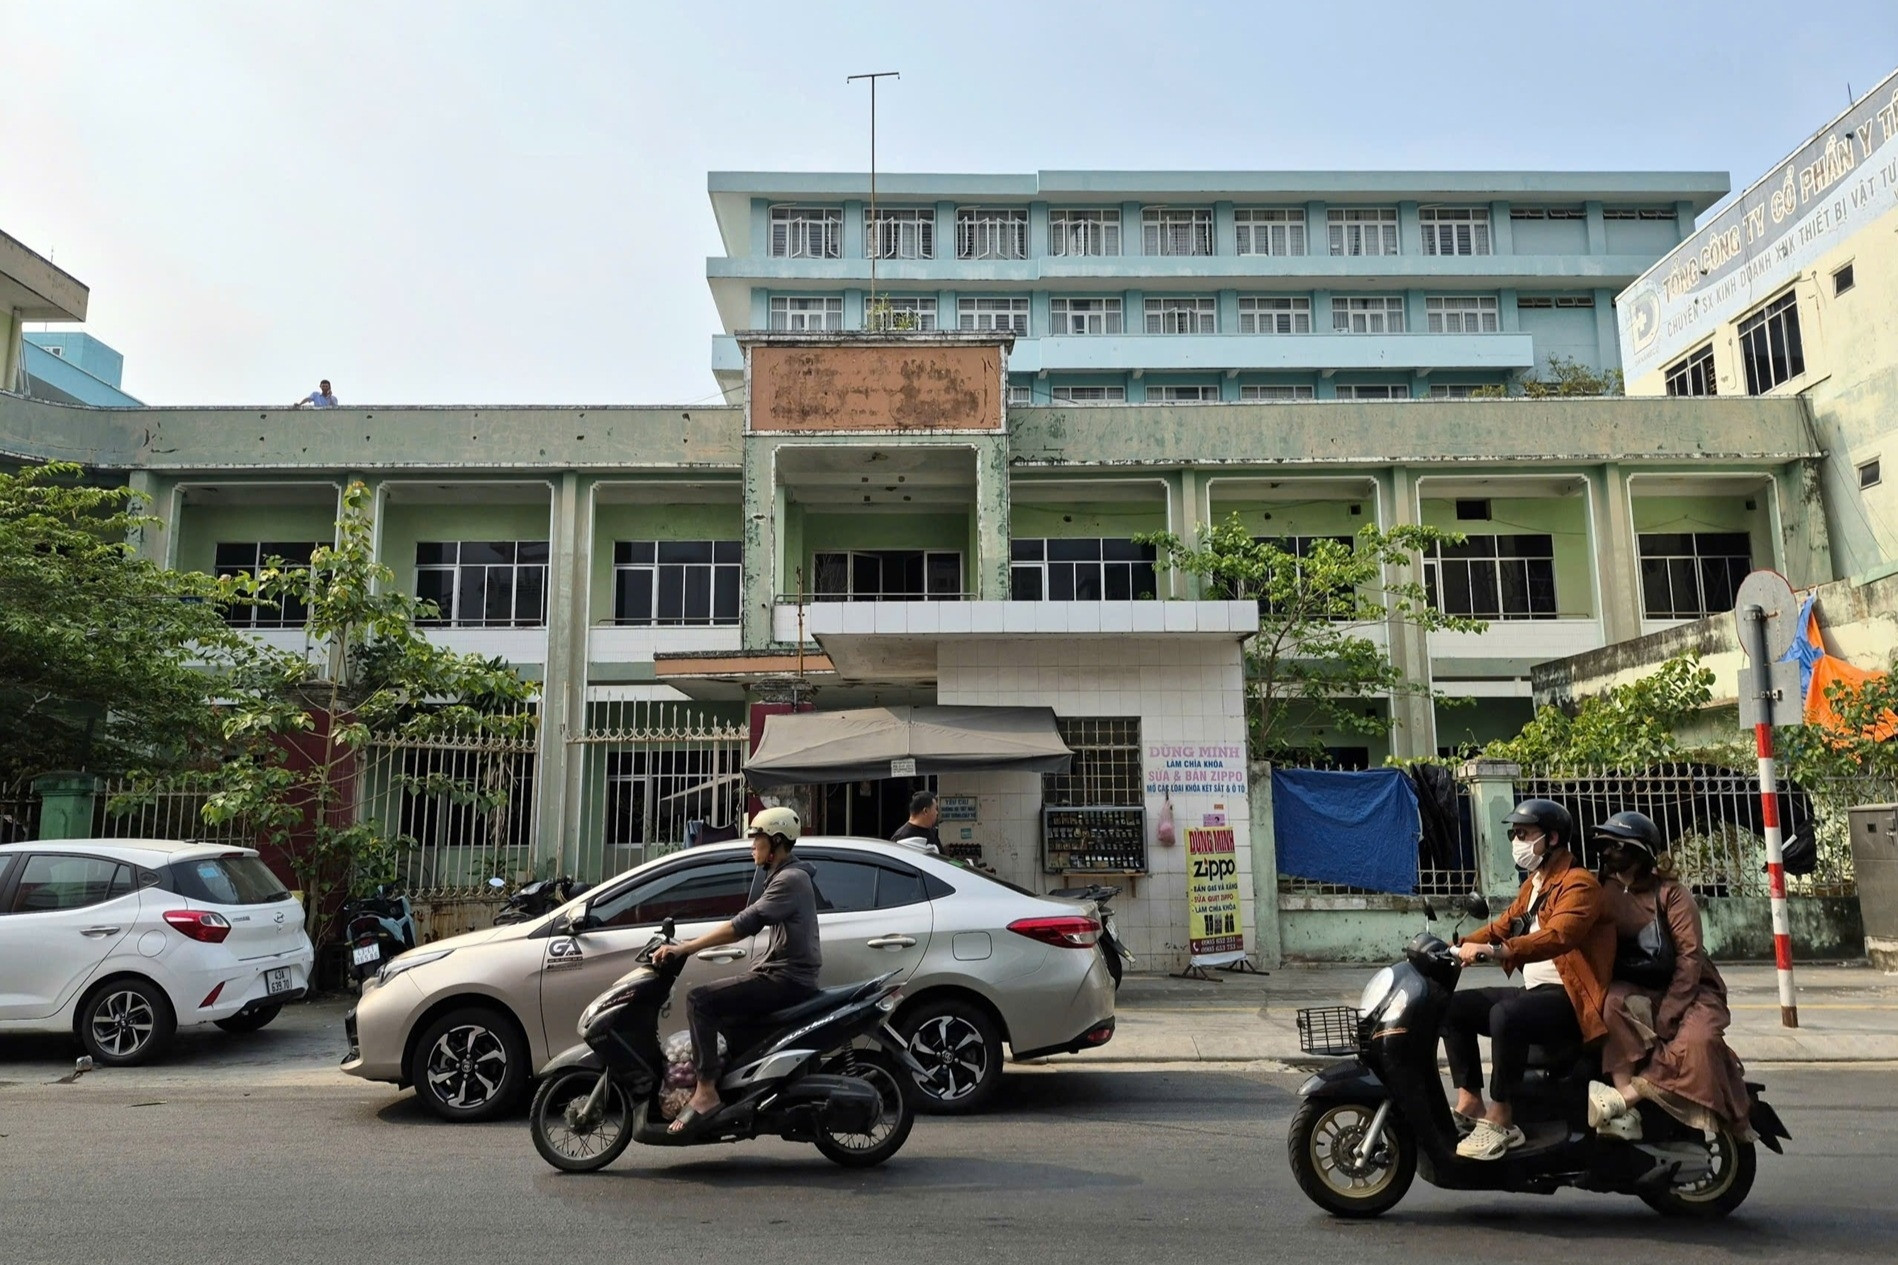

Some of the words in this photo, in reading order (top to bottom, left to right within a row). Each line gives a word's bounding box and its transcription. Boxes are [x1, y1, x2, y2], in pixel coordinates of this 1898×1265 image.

[1701, 225, 1741, 275] CÔNG
[1743, 202, 1764, 245] TY
[1856, 117, 1873, 158] Y
[1702, 293, 1714, 314] SX
[1716, 276, 1737, 304] KINH
[1740, 252, 1772, 287] DOANH
[1798, 207, 1830, 246] THIẾT
[1834, 197, 1848, 222] BỊ
[1851, 177, 1875, 209] VẬT
[1199, 746, 1240, 759] MINH
[1166, 758, 1182, 768] LÀM
[1174, 770, 1181, 781] &
[1185, 768, 1207, 782] BÁN
[1211, 771, 1243, 782] ZIPPO
[274, 969, 285, 980] 43A
